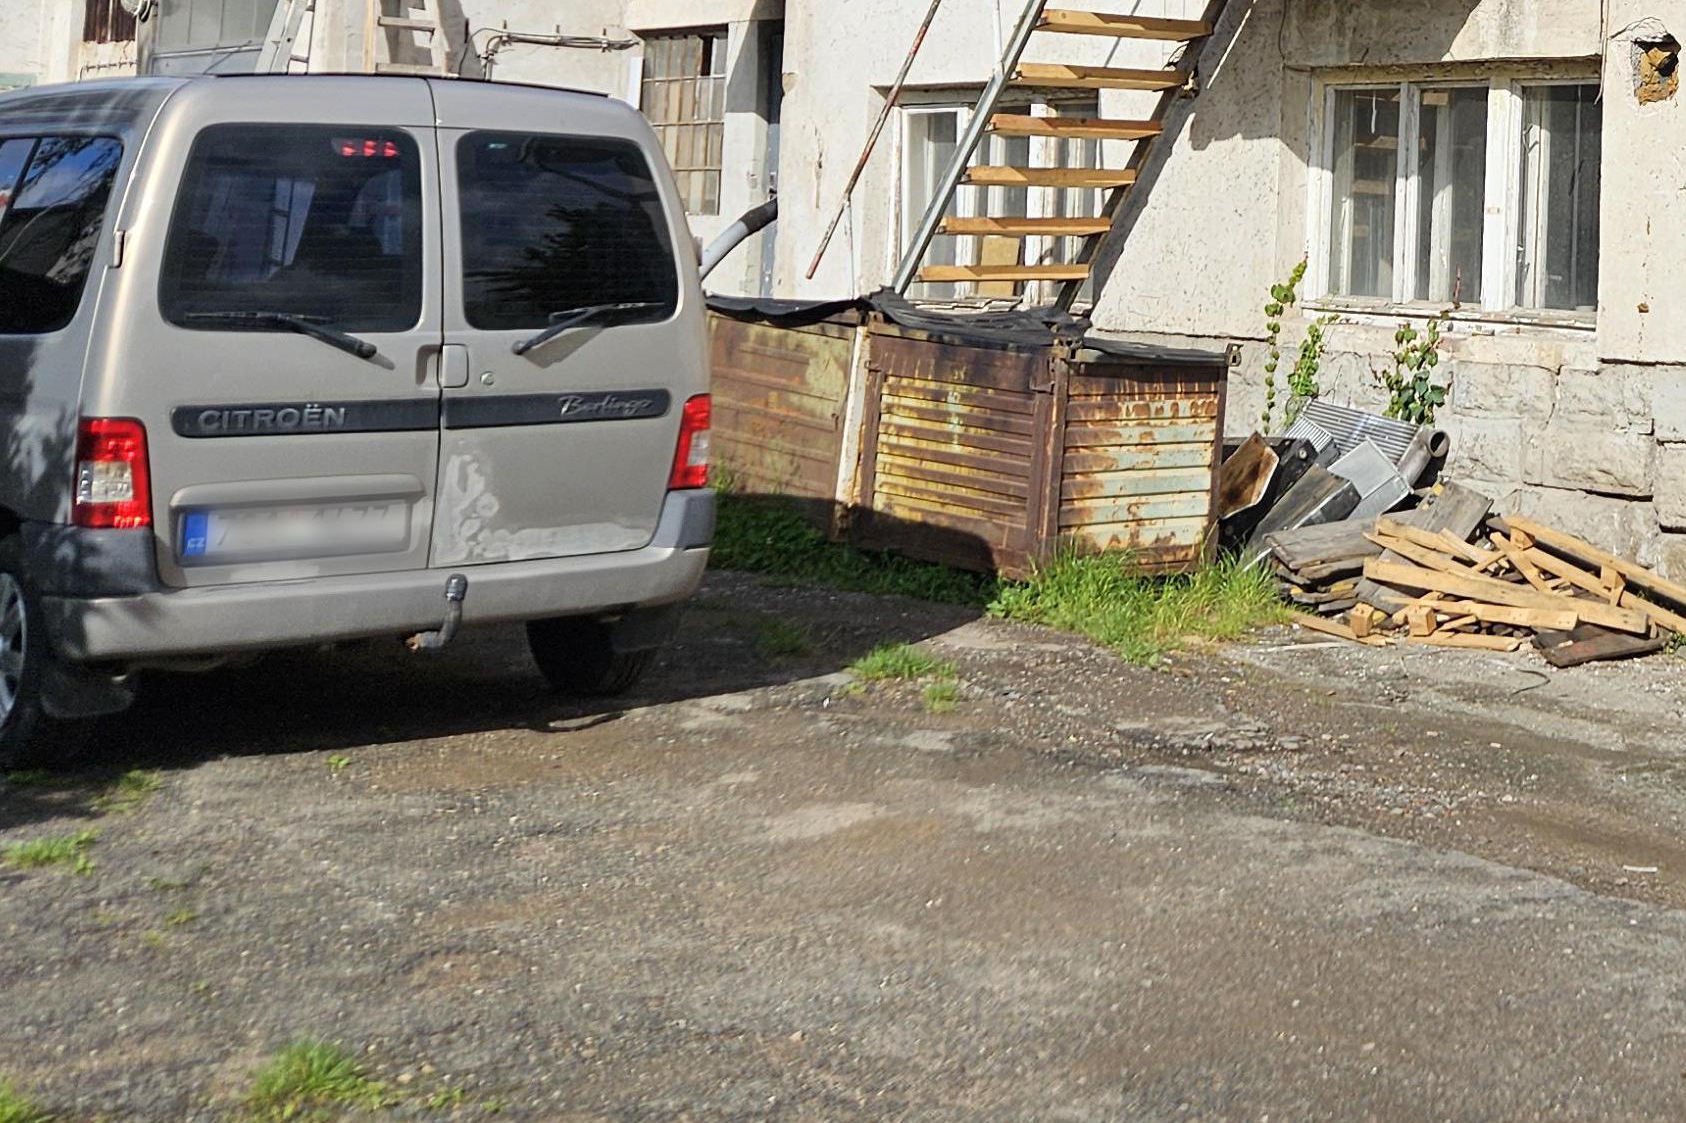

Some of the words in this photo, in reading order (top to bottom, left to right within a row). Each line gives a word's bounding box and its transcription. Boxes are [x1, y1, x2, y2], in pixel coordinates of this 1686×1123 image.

[200, 404, 347, 432] CITROËN
[558, 394, 653, 418] Berlingo
[187, 537, 205, 550] CZ
